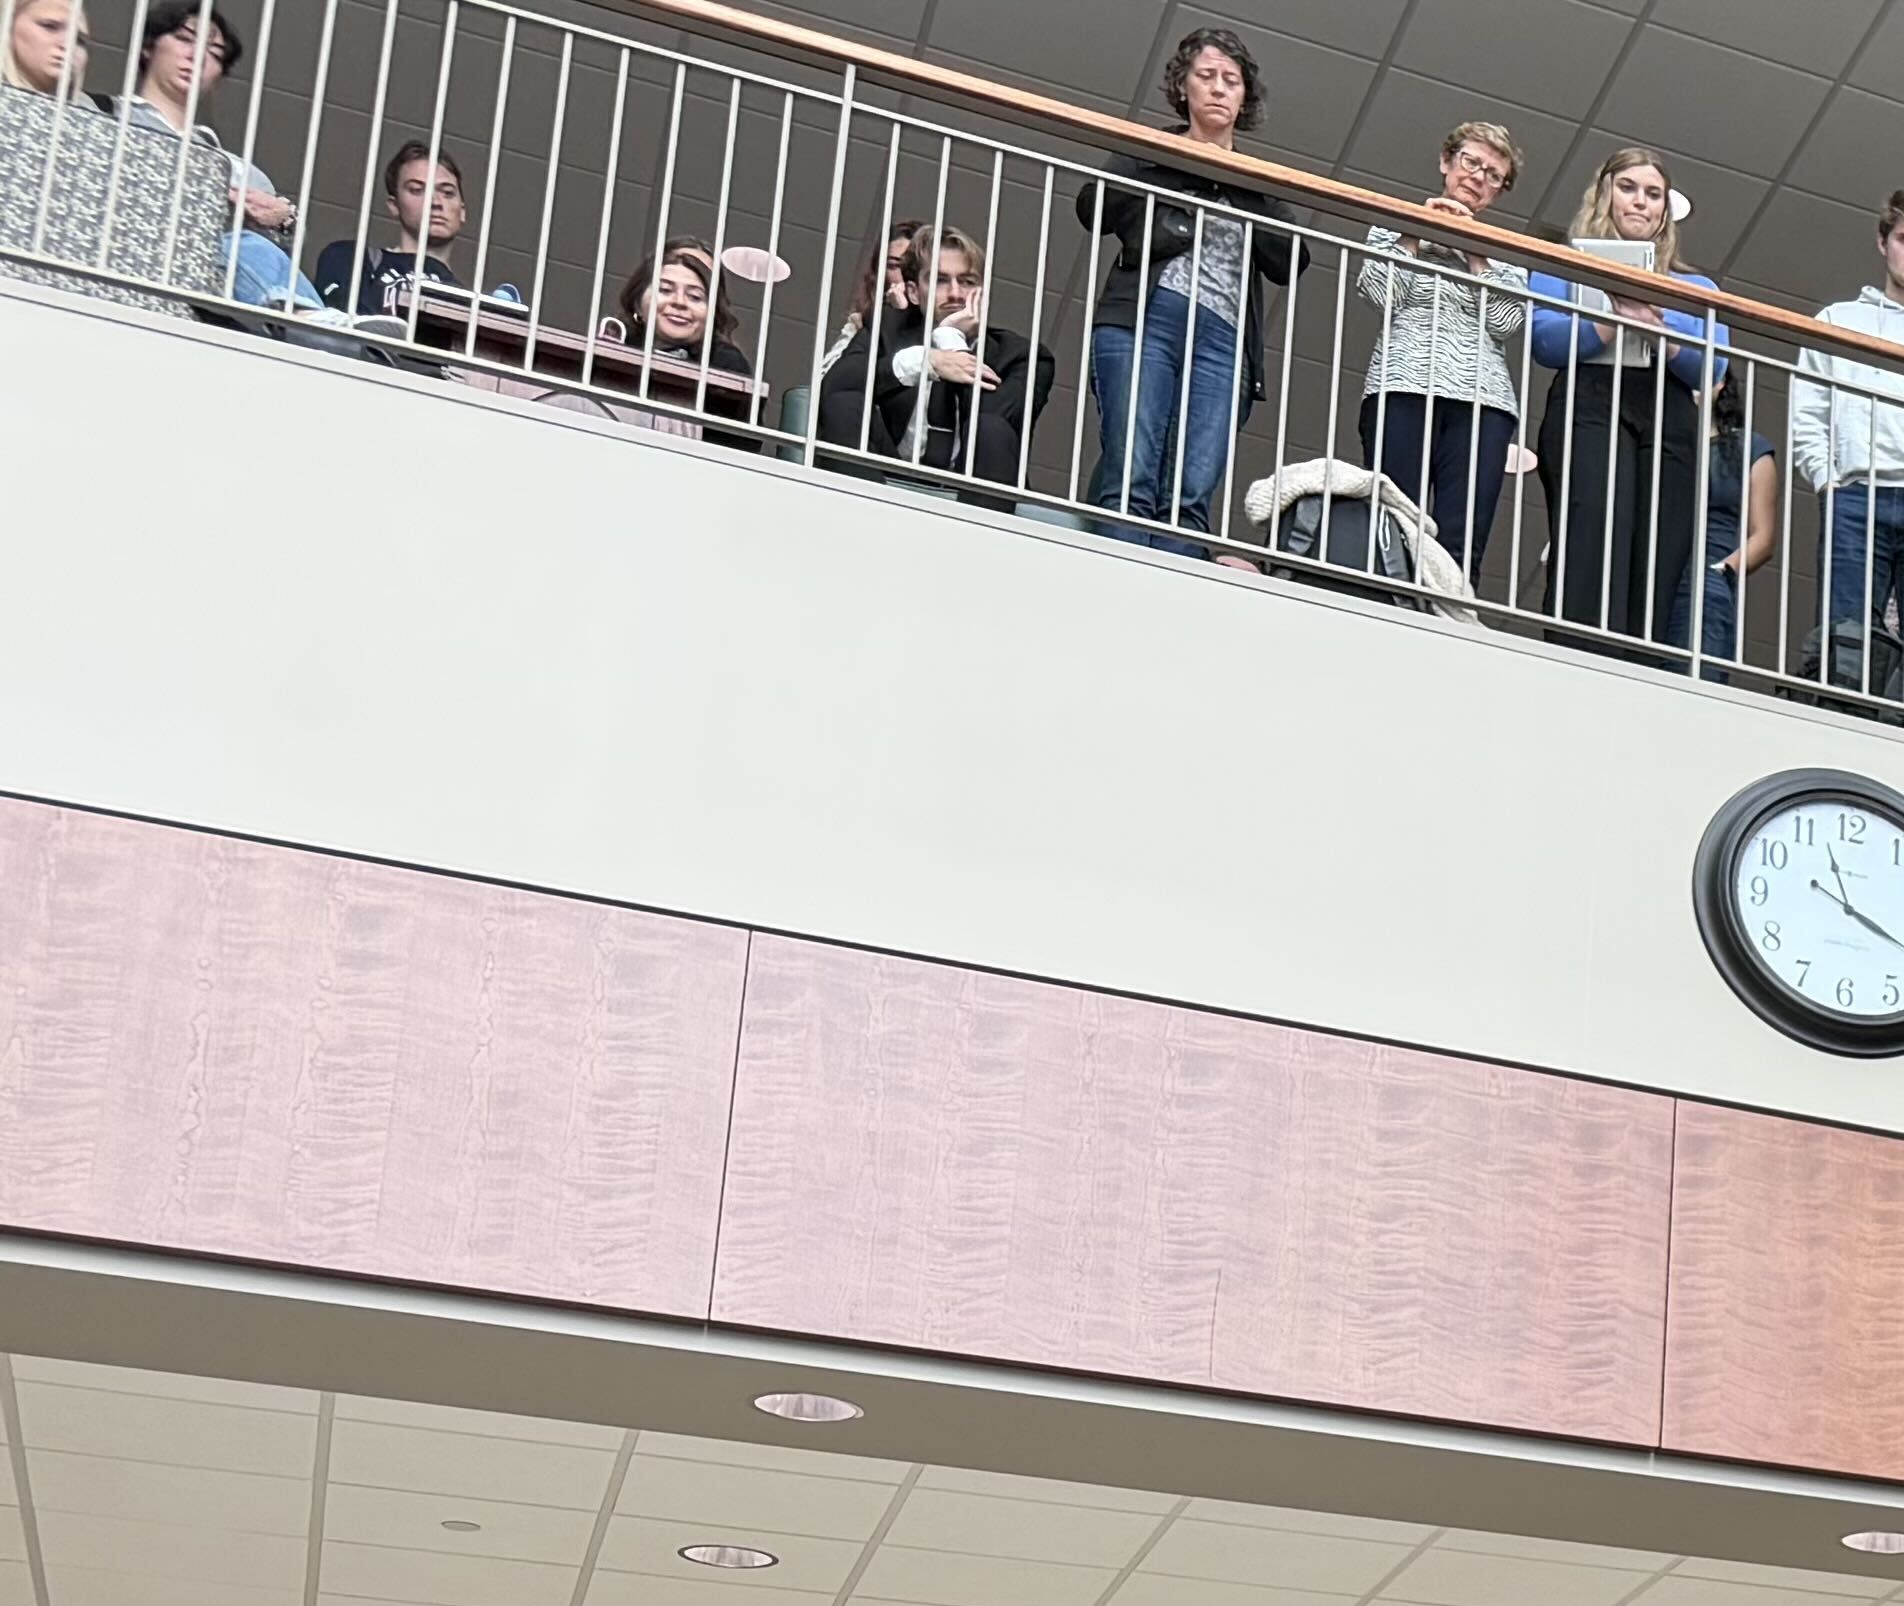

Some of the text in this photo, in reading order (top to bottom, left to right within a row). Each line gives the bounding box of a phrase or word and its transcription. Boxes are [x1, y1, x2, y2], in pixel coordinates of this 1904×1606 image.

[1794, 815, 1815, 846] 11
[1838, 813, 1867, 845] 12
[1761, 838, 1789, 870] 10
[1893, 837, 1901, 866] 1
[1750, 875, 1769, 906] 9
[1762, 920, 1781, 951] 8
[1795, 959, 1812, 987] 7
[1836, 977, 1854, 1007] 6
[1882, 974, 1900, 1007] 5
